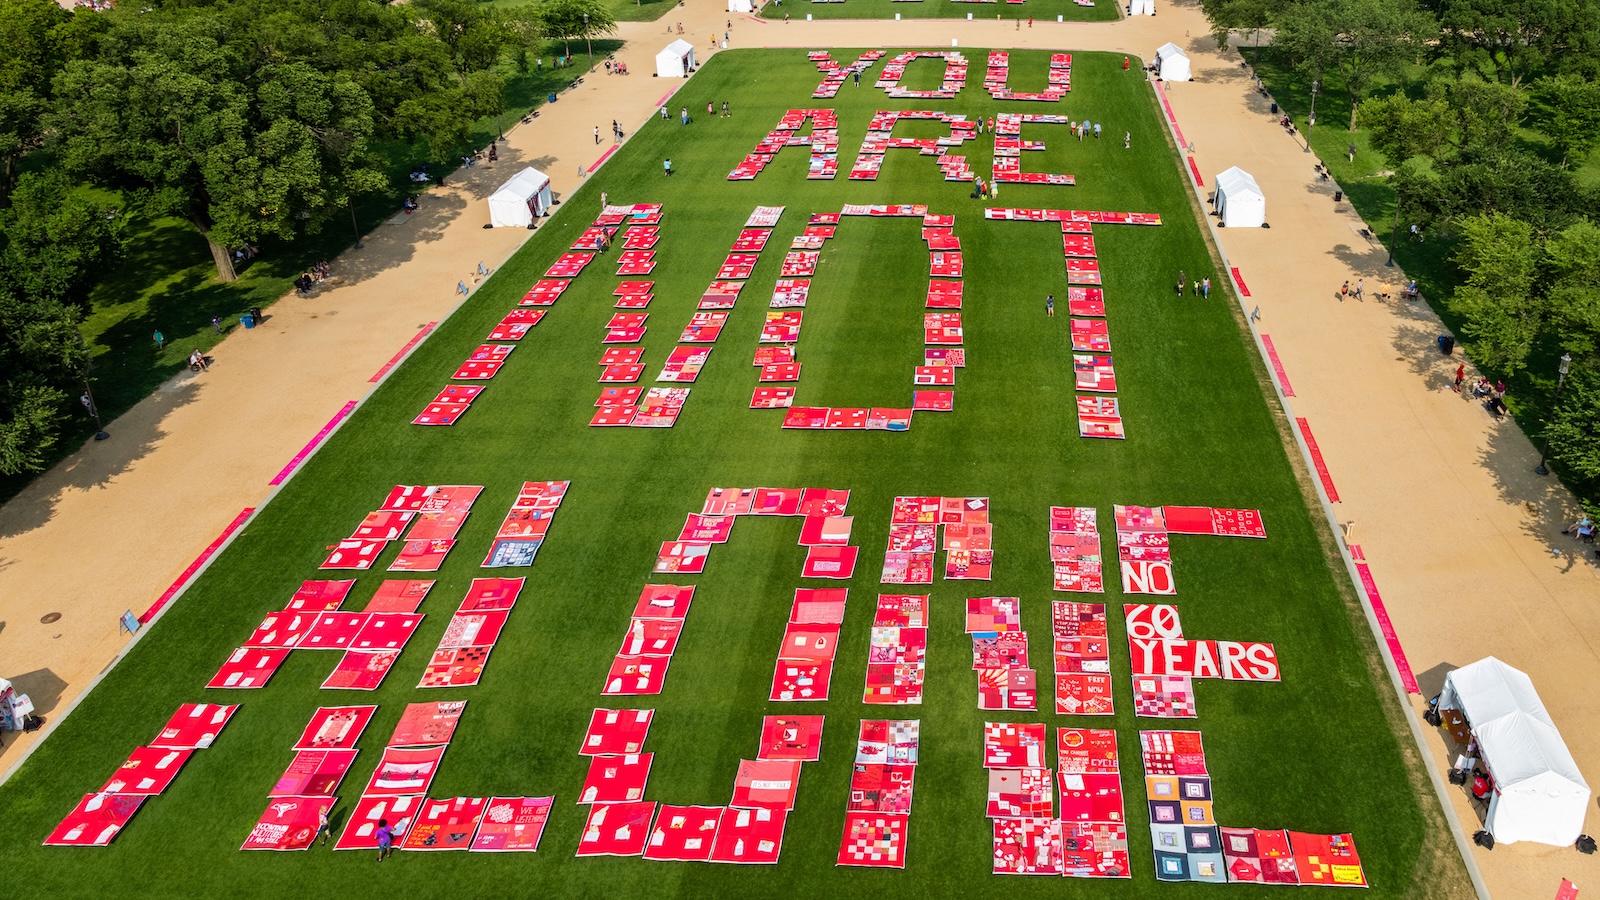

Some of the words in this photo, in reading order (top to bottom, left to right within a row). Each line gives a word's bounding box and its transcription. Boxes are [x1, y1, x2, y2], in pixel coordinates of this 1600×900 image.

[808, 50, 1073, 102] YOU
[727, 109, 1077, 186] ARE
[411, 203, 1162, 440] NOT
[1122, 561, 1177, 594] NO
[1126, 604, 1183, 639] 60
[1132, 639, 1279, 680] YEARS
[42, 480, 1368, 888] ALONE
[1087, 686, 1104, 694] NOW
[1091, 758, 1118, 767] CYCLE
[520, 806, 534, 815] WE
[536, 806, 549, 814] ARE
